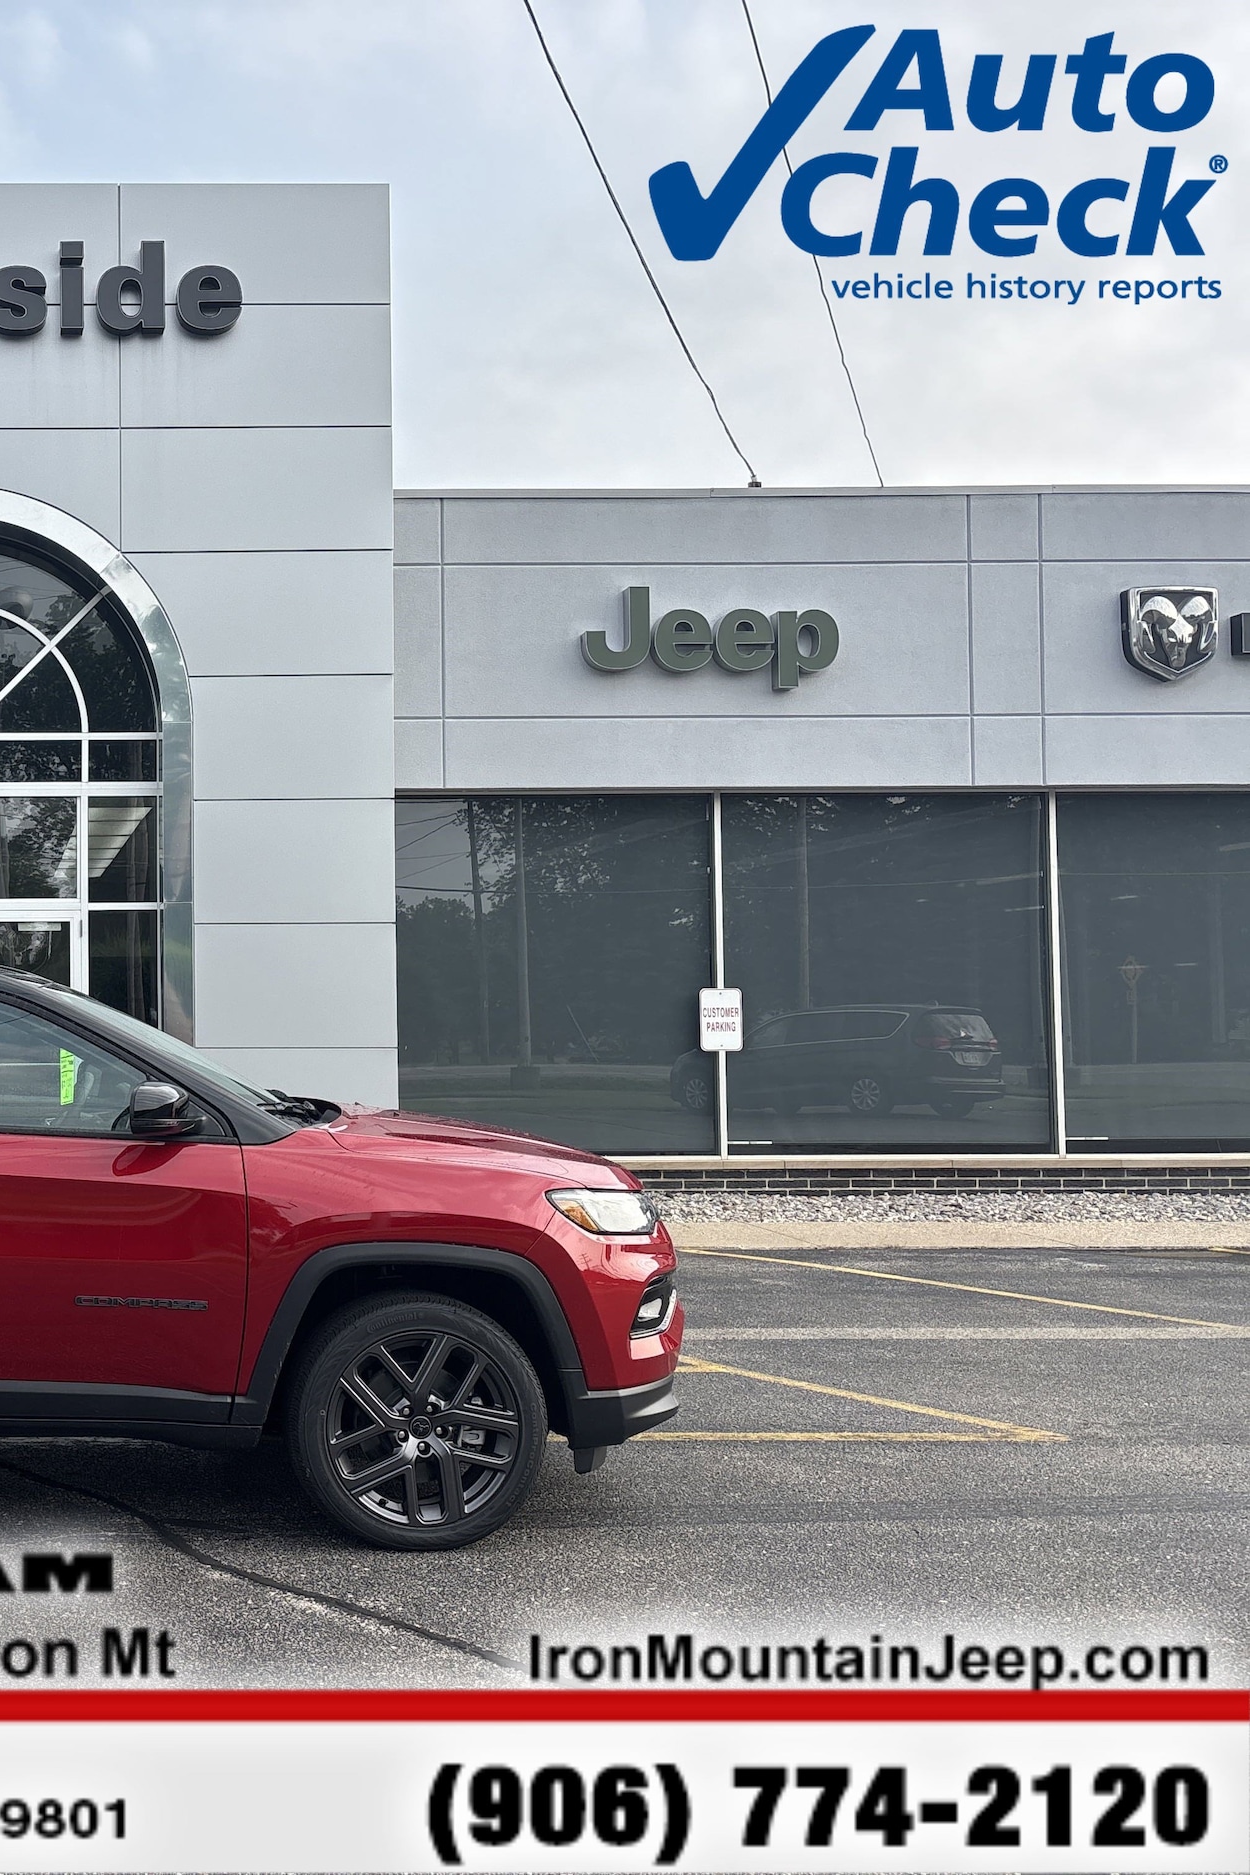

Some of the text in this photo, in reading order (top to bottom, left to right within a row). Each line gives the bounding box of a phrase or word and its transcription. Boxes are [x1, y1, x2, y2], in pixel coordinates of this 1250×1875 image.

[580, 585, 840, 691] Jeep
[702, 1007, 740, 1018] CUSTOMER
[706, 1021, 736, 1032] PARKING
[75, 1295, 209, 1311] COMPASS
